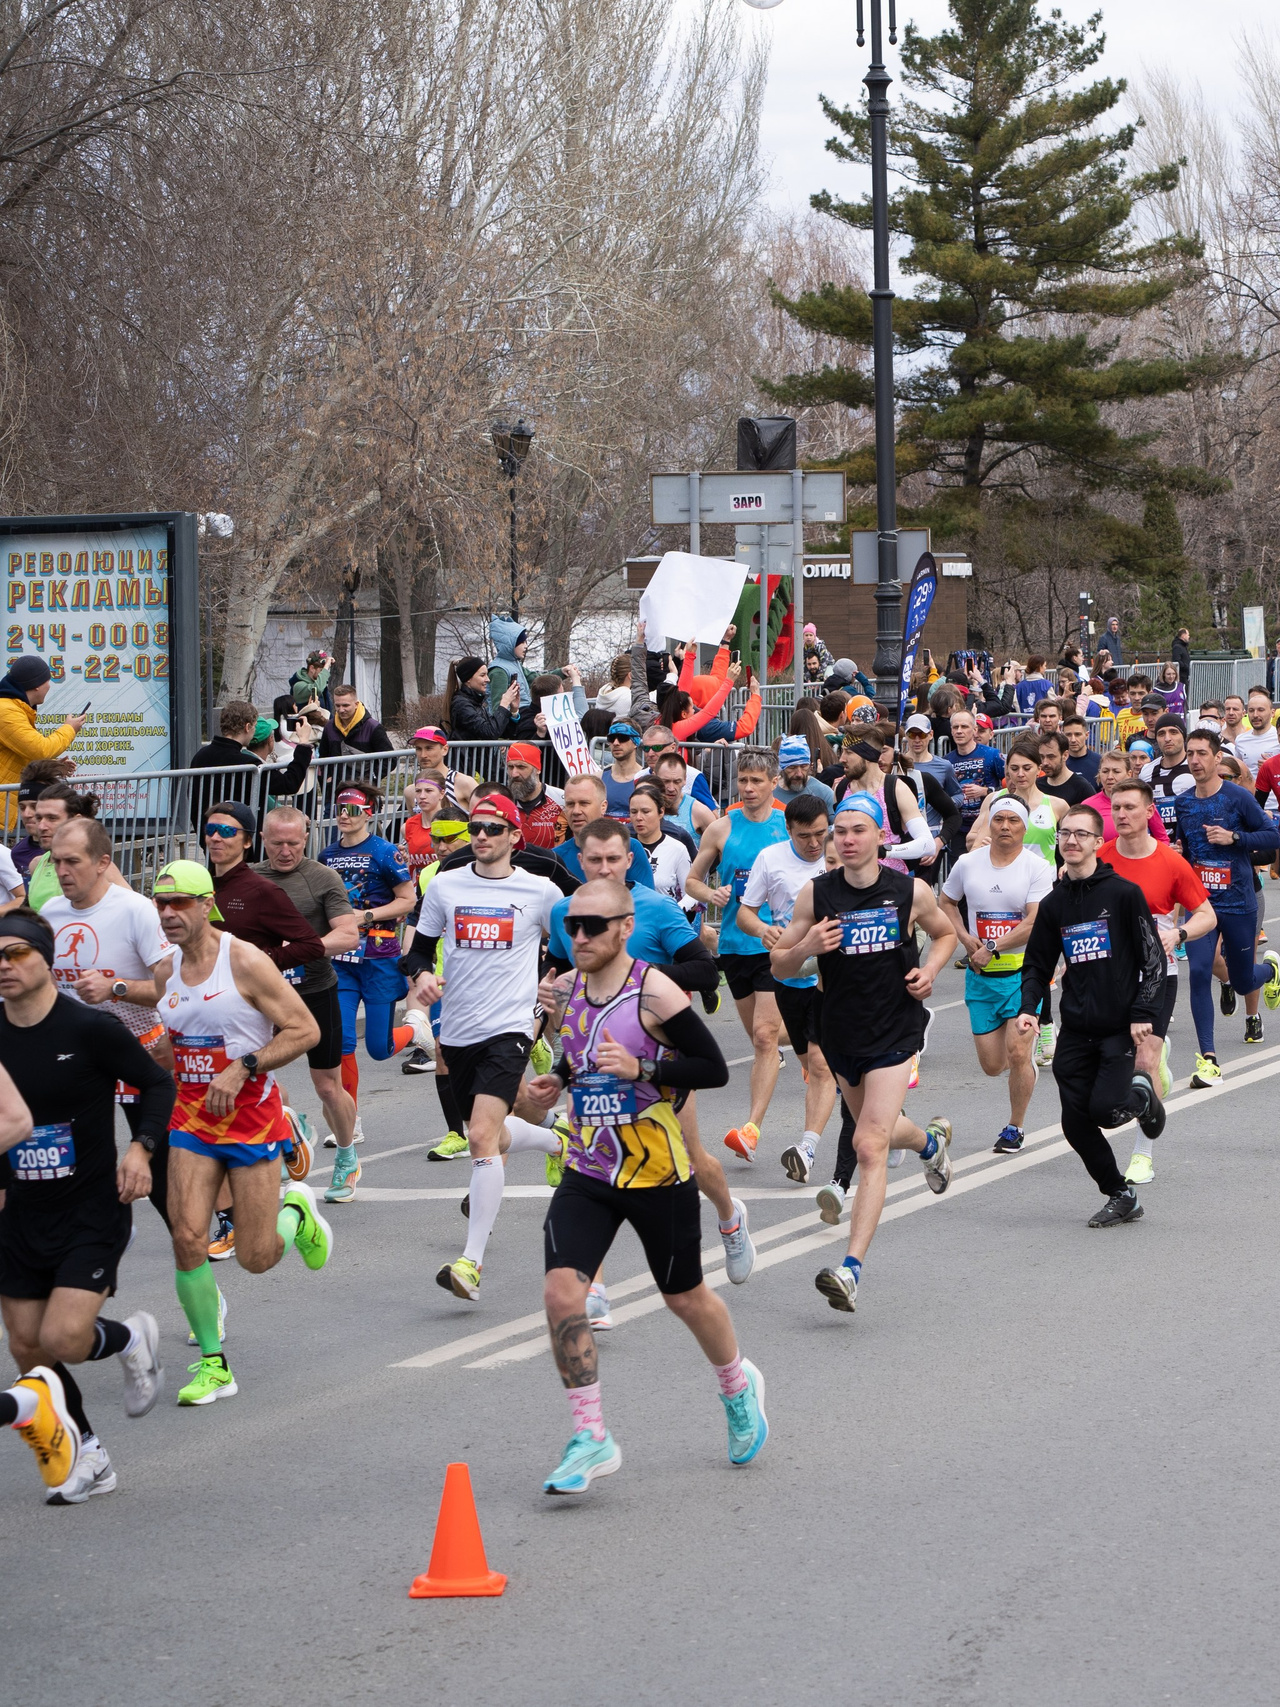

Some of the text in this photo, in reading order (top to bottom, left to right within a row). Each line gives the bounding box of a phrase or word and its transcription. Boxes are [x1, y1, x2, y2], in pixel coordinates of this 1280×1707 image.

[8, 549, 168, 577] РЕВОЛЮЦИЯ
[7, 578, 168, 613] РЕКЛАМЫ
[96, 712, 143, 723] РЕКЛАМЫ
[100, 725, 168, 738] ПАВИЛЬОНАХ,
[86, 741, 93, 750] И
[96, 740, 134, 751] ХОРЕКЕ.
[1201, 871, 1220, 883] 1168
[467, 923, 499, 939] 1799
[851, 926, 888, 944] 2072
[1072, 936, 1100, 954] 2322
[183, 1055, 215, 1072] 1452
[582, 1094, 621, 1114] 2203
[17, 1147, 60, 1168] 2099
